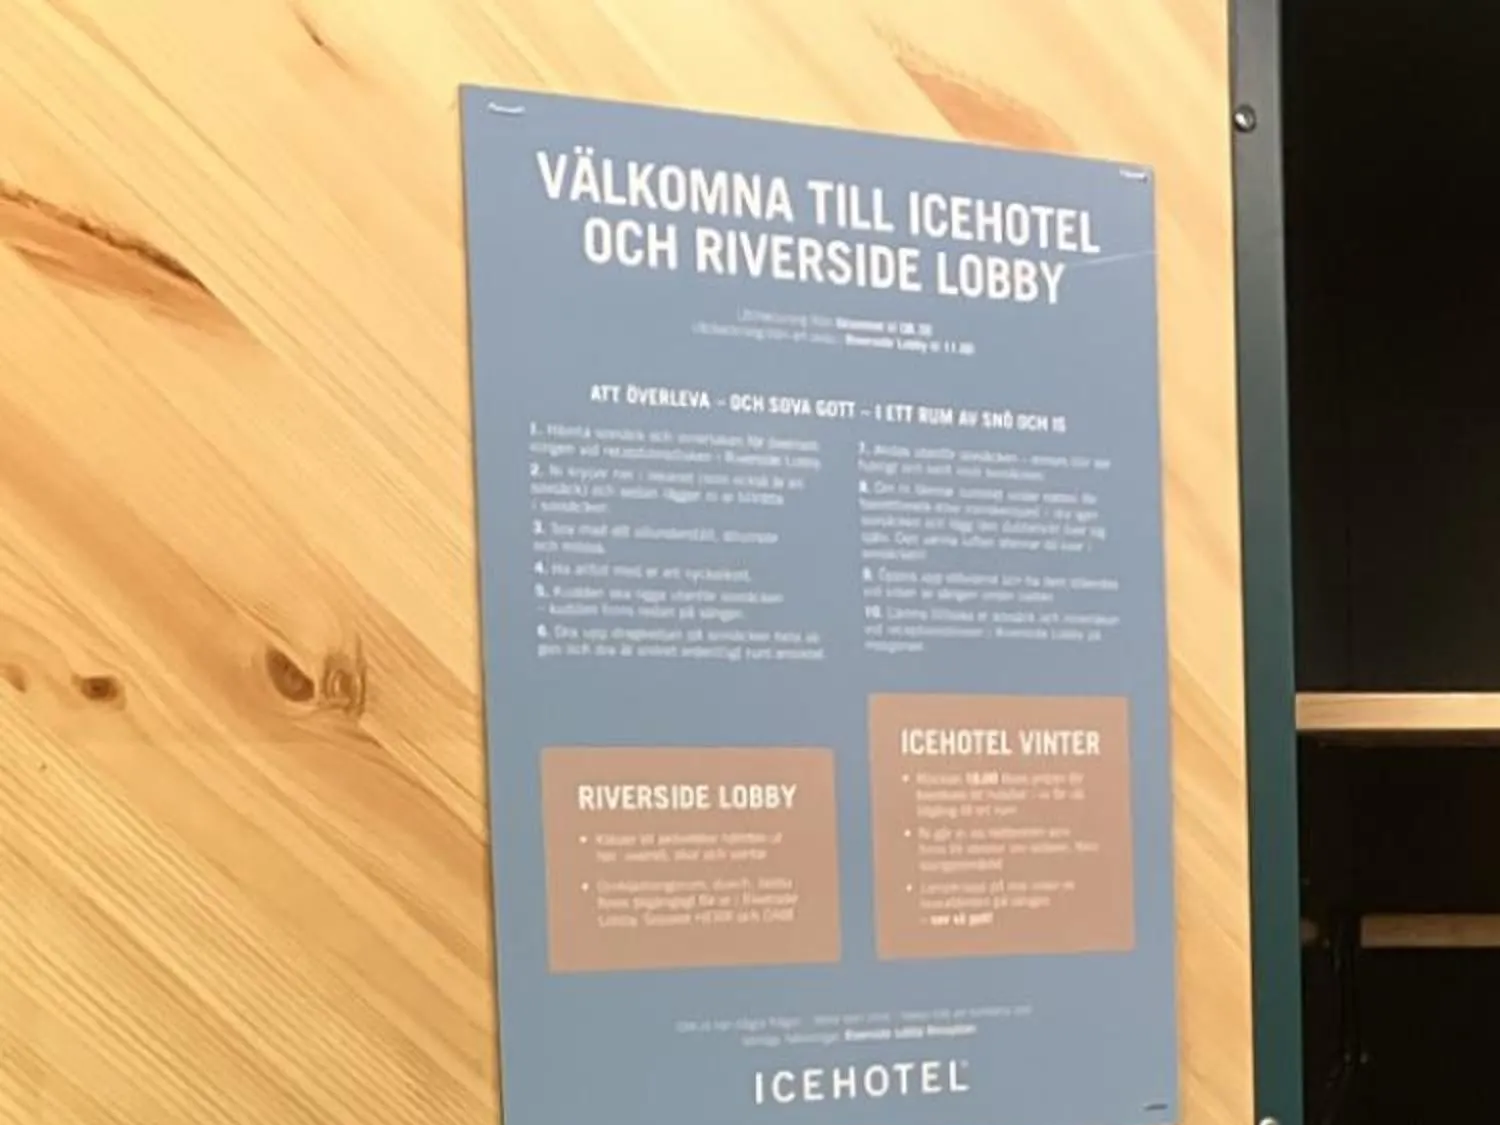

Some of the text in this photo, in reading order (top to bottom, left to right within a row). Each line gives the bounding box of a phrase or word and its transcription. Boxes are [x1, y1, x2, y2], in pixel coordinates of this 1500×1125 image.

[537, 147, 1101, 254] VÄLKOMNA TILL ICEHOTEL
[583, 217, 1065, 304] OCH RIVERSIDE LOBBY
[591, 384, 620, 401] ATT
[627, 383, 710, 409] ÖVERLEVA
[730, 394, 764, 412] OCH
[769, 396, 811, 415] SOVA
[816, 399, 856, 418] GOTT
[887, 405, 912, 423] ETT
[919, 406, 952, 425] RUM
[958, 409, 978, 426] AV
[982, 409, 1013, 429] SNÖ
[1017, 414, 1048, 432] OCH
[1052, 416, 1067, 433] IS
[901, 728, 1100, 756] ICEHOTEL VINTER
[578, 784, 797, 810] RIVERSIDE LOBBY
[755, 1059, 969, 1105] ICEHOTEL
